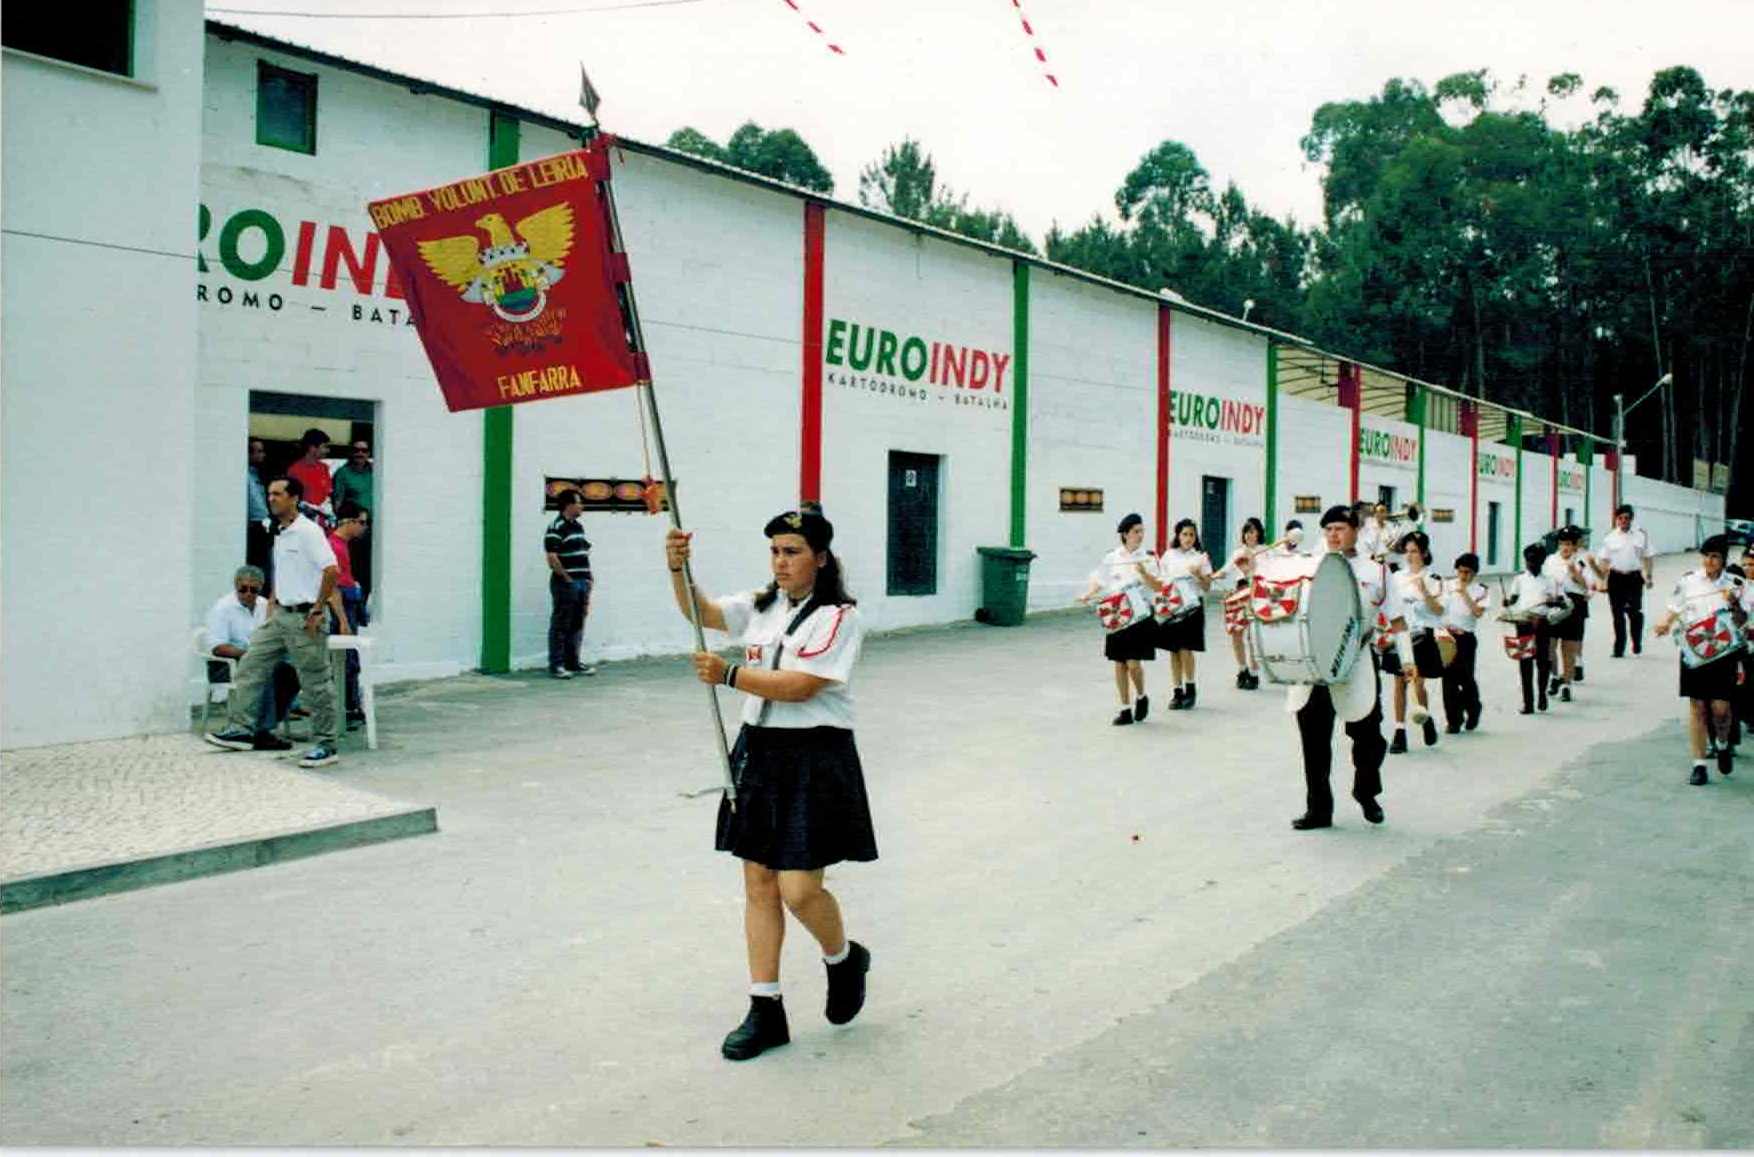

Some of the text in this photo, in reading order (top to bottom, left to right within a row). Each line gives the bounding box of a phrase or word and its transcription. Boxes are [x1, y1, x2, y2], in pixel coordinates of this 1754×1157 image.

[826, 318, 1011, 393] EUROINDY
[498, 364, 583, 399] FANFARRA
[1169, 389, 1265, 435] EUROINDY
